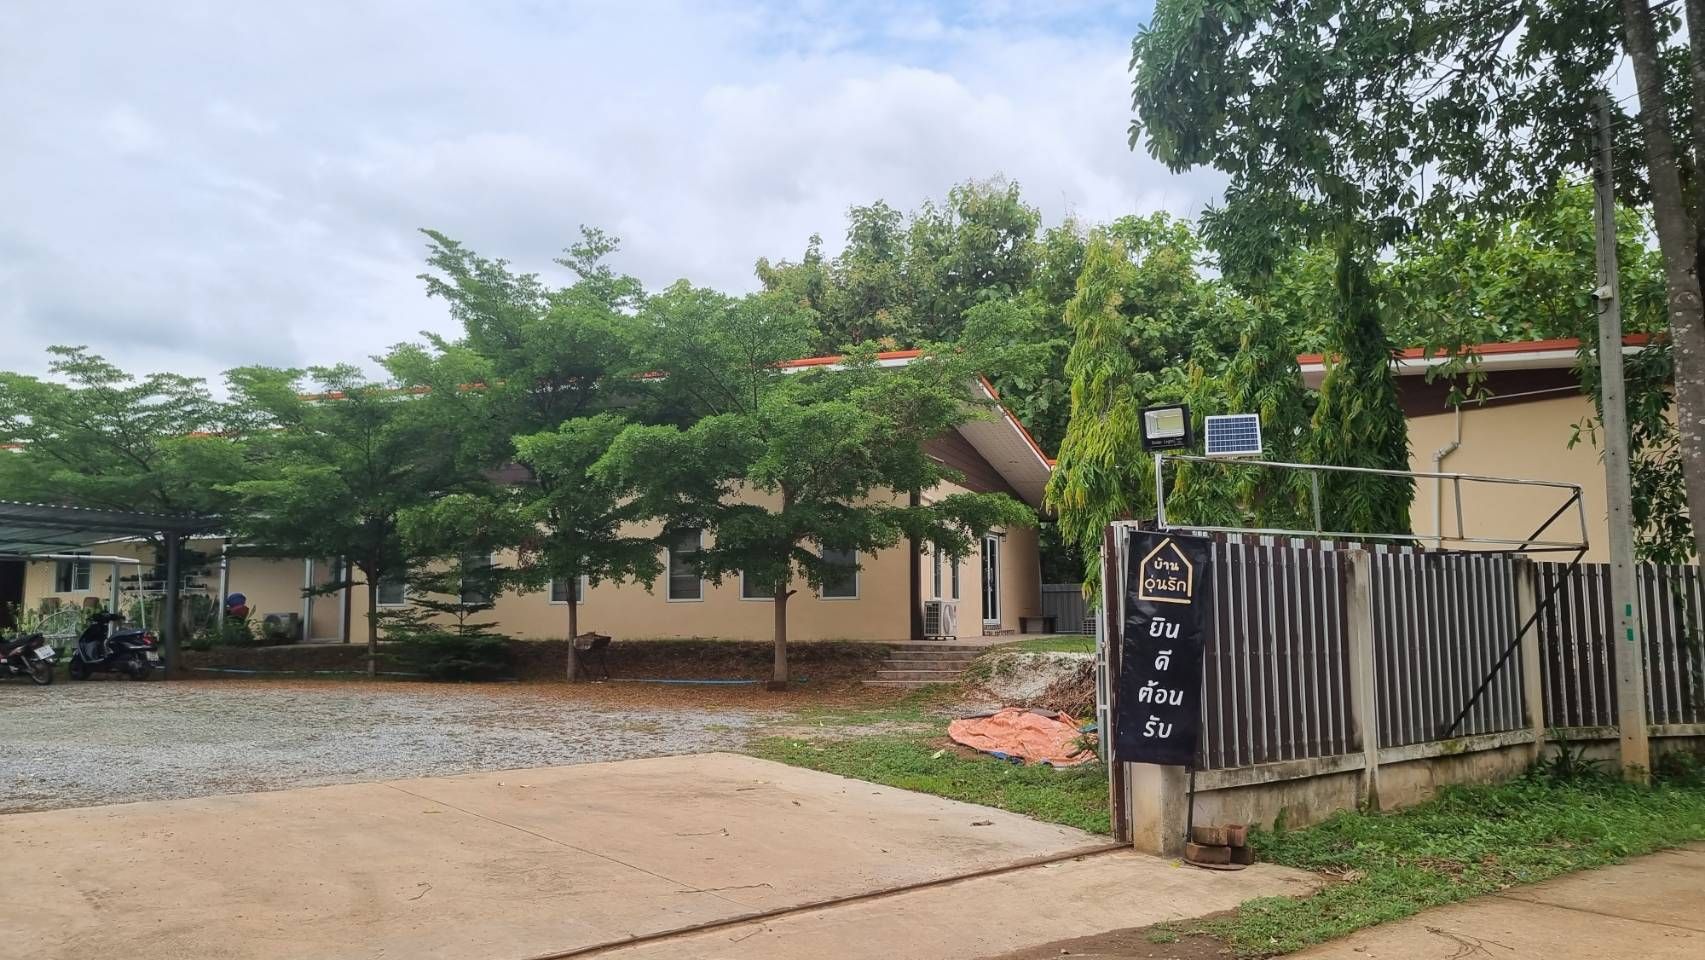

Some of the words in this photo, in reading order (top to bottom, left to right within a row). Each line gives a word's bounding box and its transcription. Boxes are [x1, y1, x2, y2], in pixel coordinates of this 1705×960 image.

[1153, 557, 1180, 572] บ้าน
[1144, 574, 1187, 593] อุ่นรัก
[1149, 616, 1180, 639] ยิน
[1154, 649, 1173, 671] ดี
[1138, 679, 1184, 706] ต้อน
[1143, 714, 1173, 739] รับ
